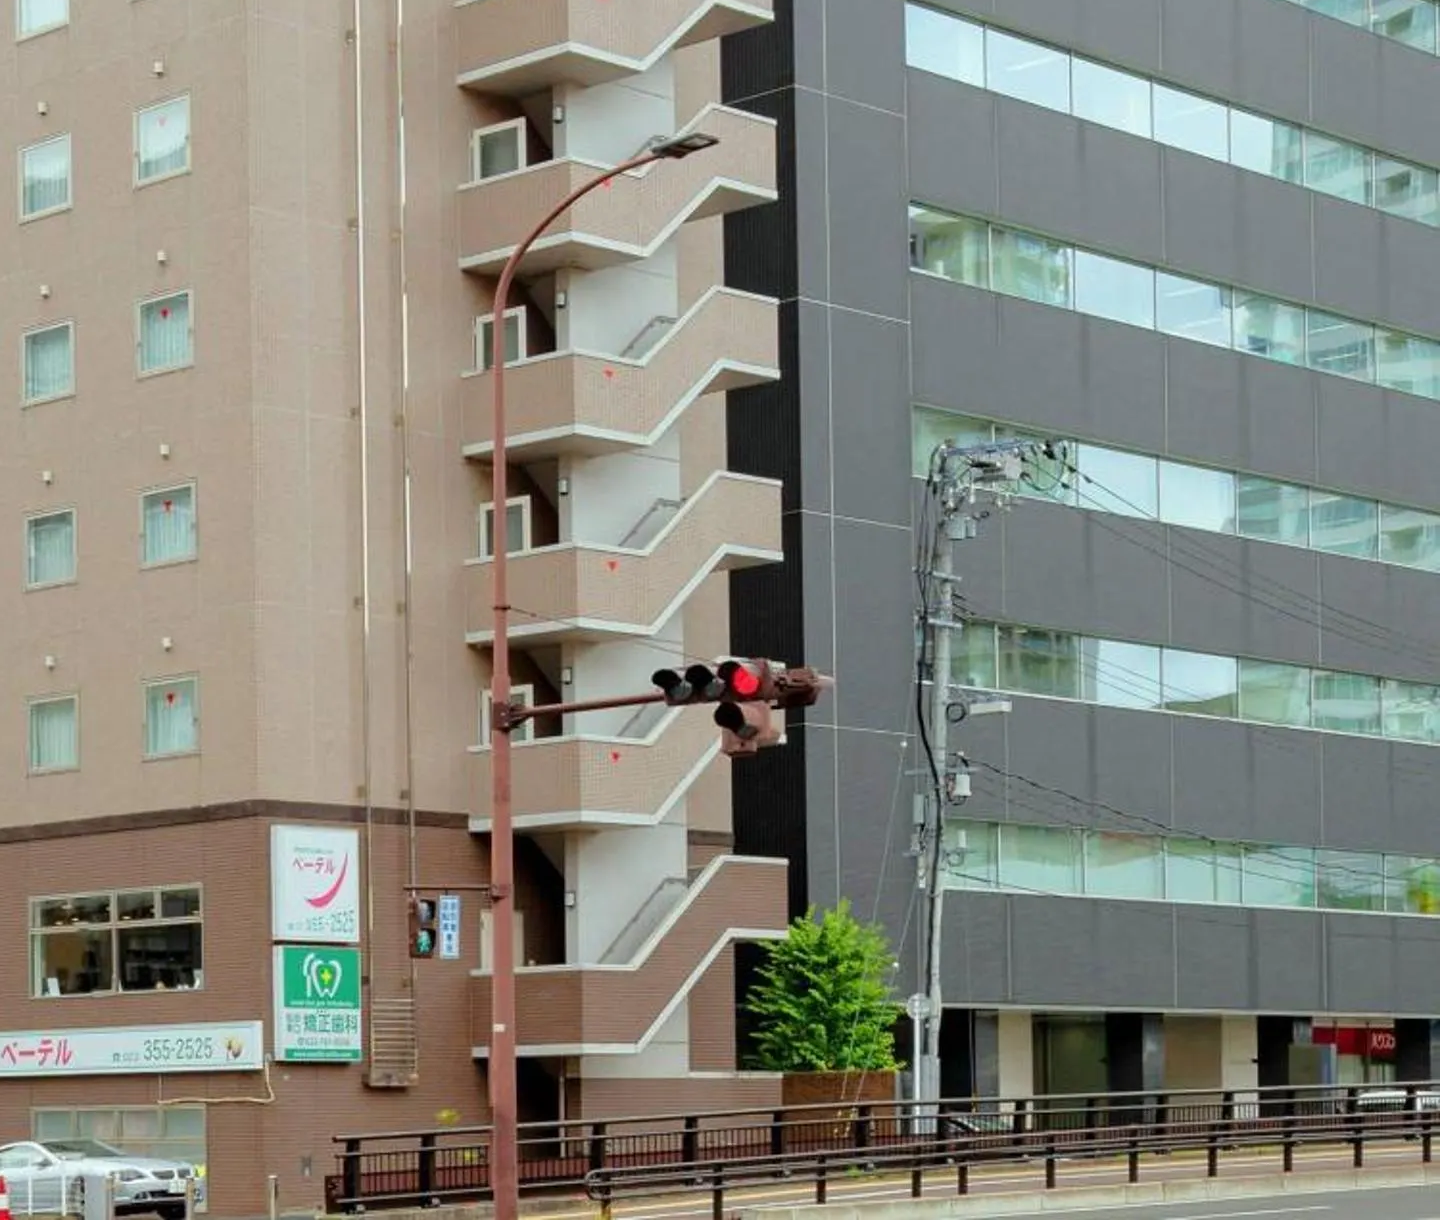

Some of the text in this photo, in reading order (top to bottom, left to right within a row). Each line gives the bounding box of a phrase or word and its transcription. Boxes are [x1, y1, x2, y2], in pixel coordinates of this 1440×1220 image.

[292, 856, 336, 875] ベーテル
[0, 1038, 73, 1066] ベーテル
[143, 1037, 214, 1061] 355-2525
